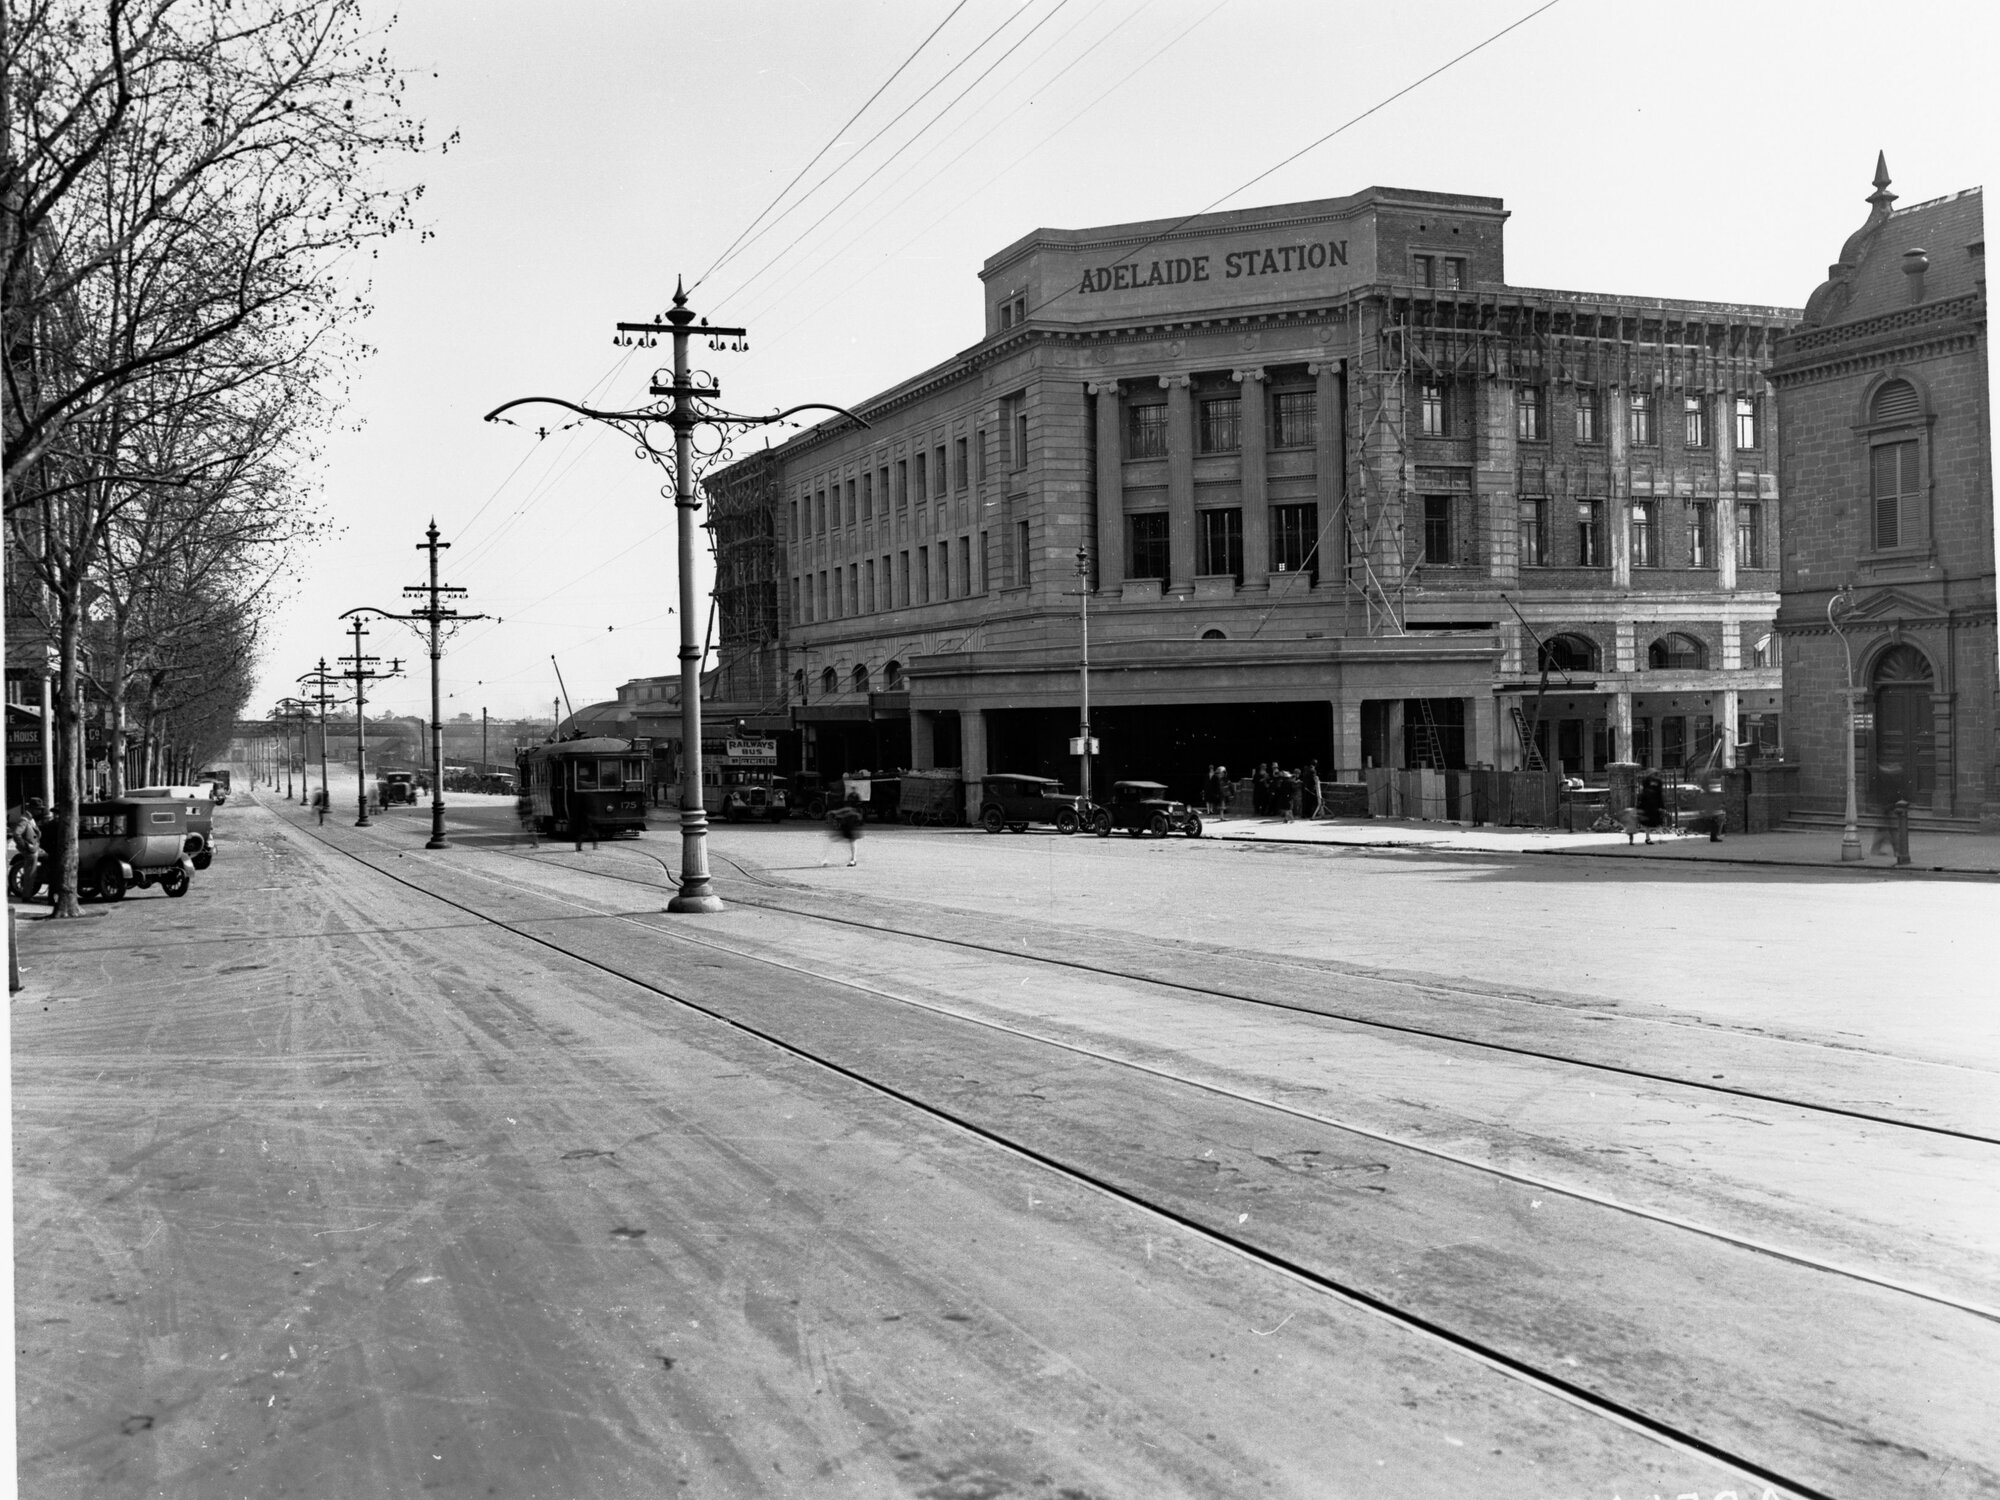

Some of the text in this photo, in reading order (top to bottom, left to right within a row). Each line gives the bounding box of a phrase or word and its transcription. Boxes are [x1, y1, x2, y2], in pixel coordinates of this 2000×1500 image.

[1079, 240, 1348, 294] ADELAIDE STATION
[13, 730, 39, 742] HOUSE
[729, 741, 775, 750] RAILWAYS
[621, 801, 637, 809] 175
